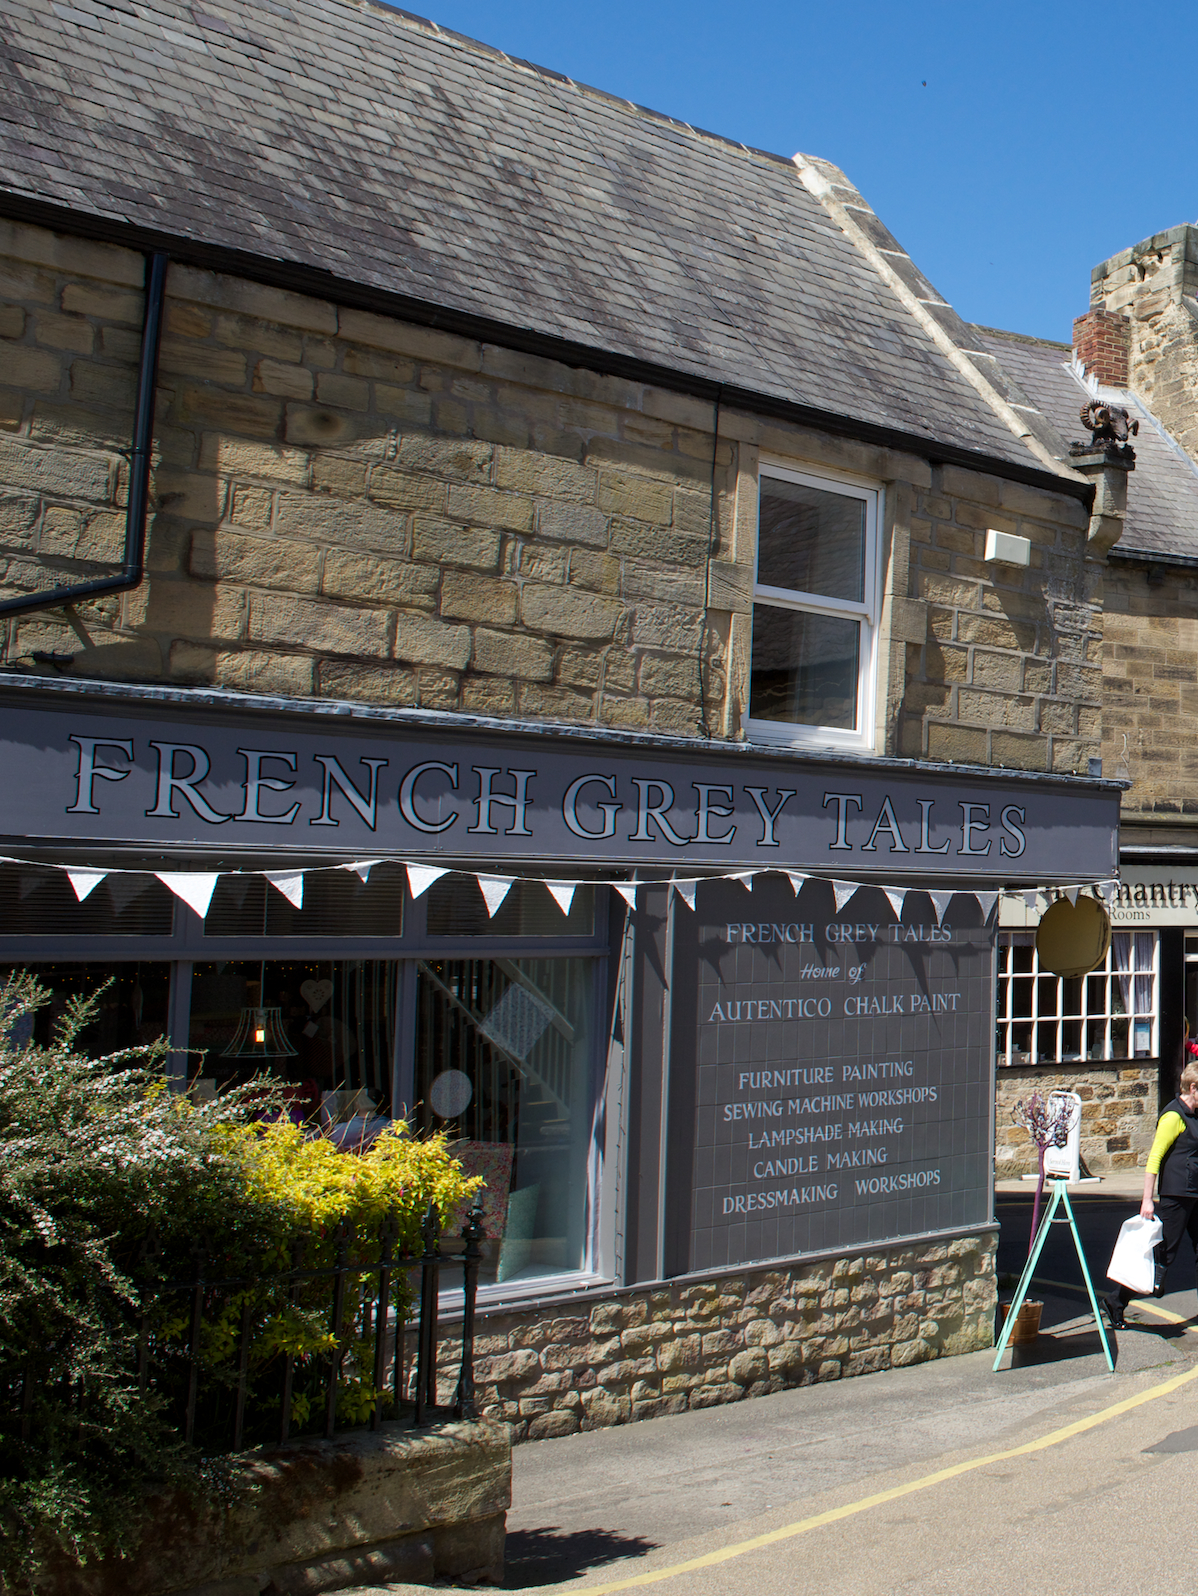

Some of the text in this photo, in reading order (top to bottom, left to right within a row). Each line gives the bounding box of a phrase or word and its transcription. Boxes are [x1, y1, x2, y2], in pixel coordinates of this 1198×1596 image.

[66, 734, 1027, 859] FRENCH GREY TALES
[1109, 906, 1151, 920] Rooms
[725, 922, 952, 943] FRENCH GREY TALES
[800, 963, 867, 985] Home of
[708, 993, 961, 1022] AUTENTICO CHALK PAINT
[738, 1061, 913, 1090] FURNITURE PAINTING
[724, 1086, 938, 1122] SEWING MACHINE WORKSHOPS
[749, 1117, 904, 1150] LAMPSHADE MAKING
[754, 1147, 888, 1179] CANDLE MAKING
[722, 1169, 941, 1215] DRESSMAKING WORKSHOPS
